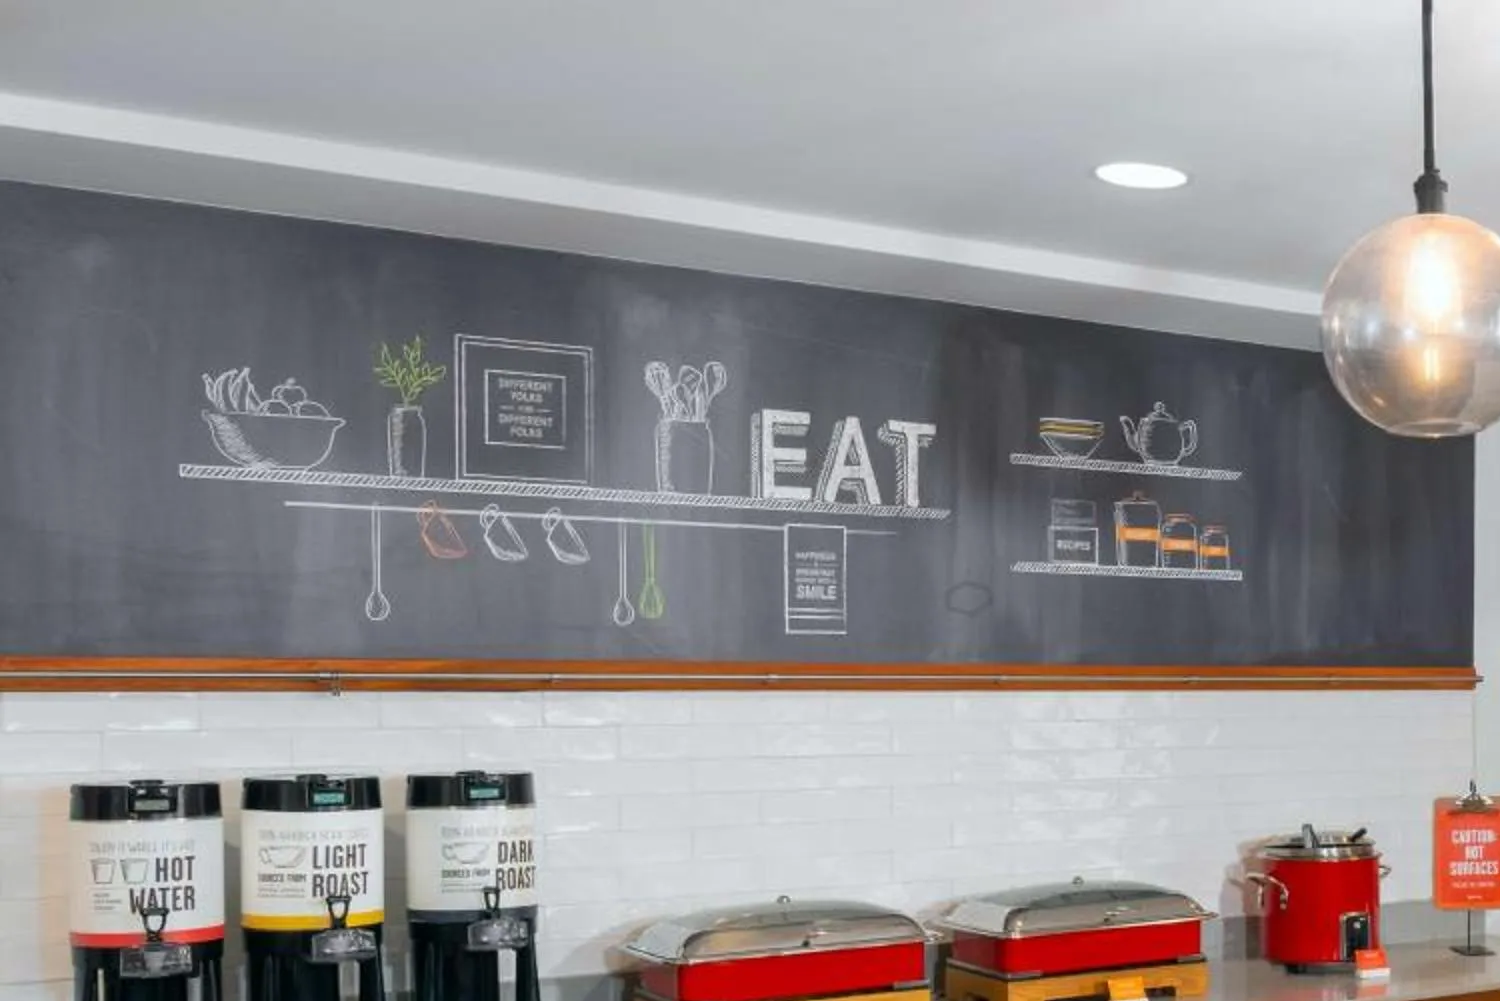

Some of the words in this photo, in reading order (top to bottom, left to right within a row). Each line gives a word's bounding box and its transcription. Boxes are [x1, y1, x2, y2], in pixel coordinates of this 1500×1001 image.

[751, 408, 937, 508] EAT
[796, 585, 837, 600] SMILE
[312, 843, 367, 869] LIGHT
[497, 840, 535, 865] DARK
[1465, 845, 1484, 860] HOT
[155, 856, 196, 882] HOT
[495, 865, 537, 890] ROAST
[1450, 861, 1499, 876] SURFACES
[312, 871, 369, 898] ROAST
[128, 885, 196, 914] WATER
